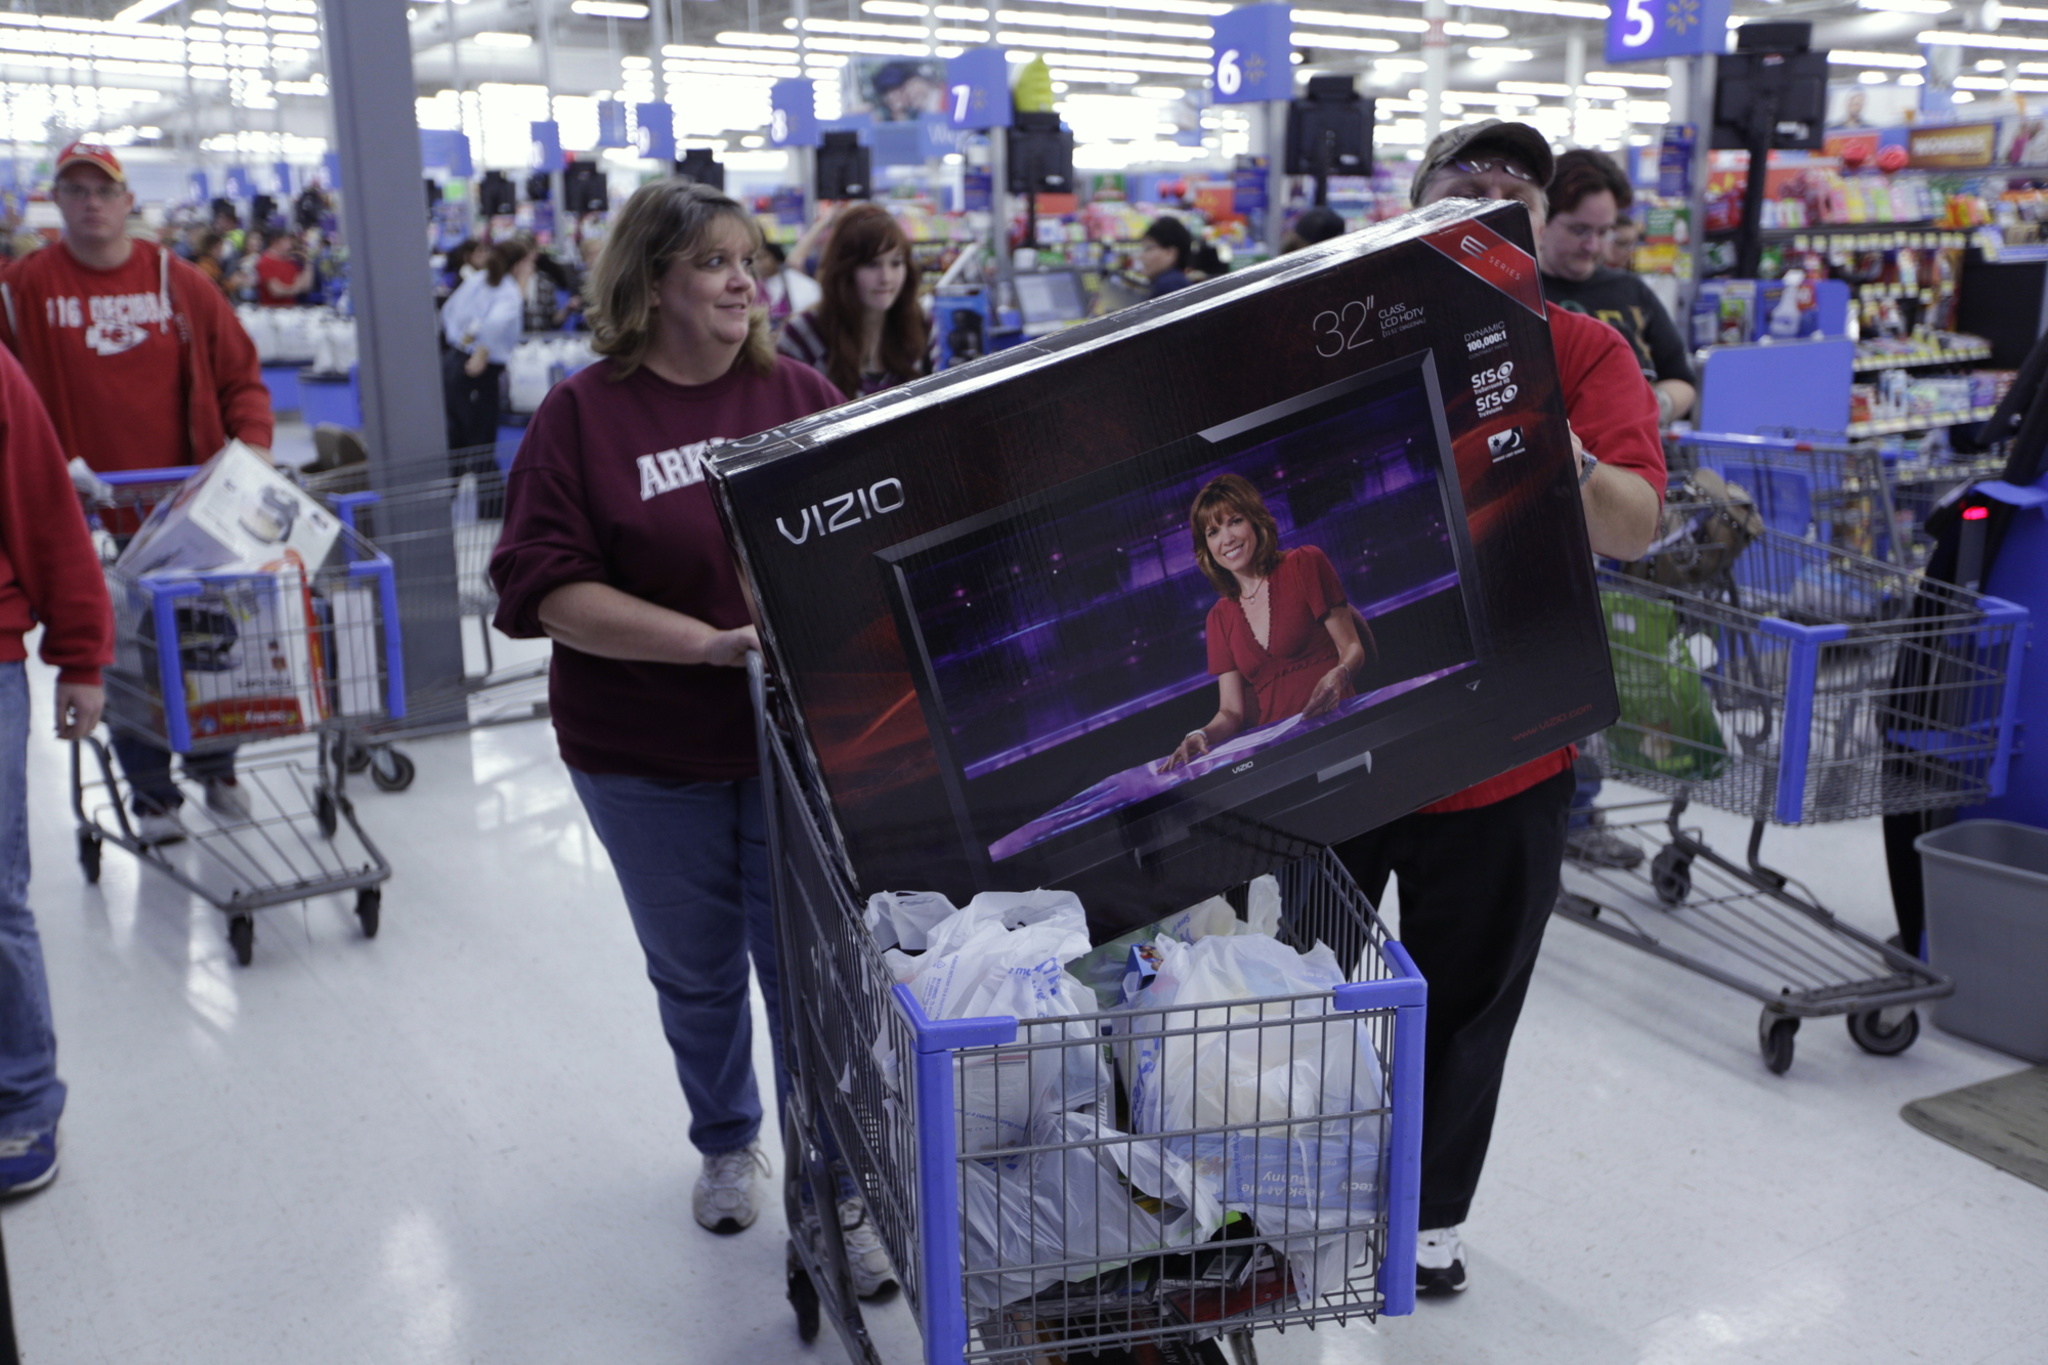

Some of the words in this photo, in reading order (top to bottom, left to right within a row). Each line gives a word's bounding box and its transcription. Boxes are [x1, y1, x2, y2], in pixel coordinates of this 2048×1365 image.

[1622, 0, 1655, 47] 5
[1217, 48, 1242, 95] 6
[951, 84, 971, 123] 7
[770, 108, 788, 143] 8
[1488, 255, 1521, 281] SERIES
[1377, 302, 1406, 319] CLASS
[1379, 315, 1399, 330] LCD
[1400, 306, 1424, 323] HDTV
[1312, 294, 1374, 358] 32"
[1463, 320, 1506, 342] DYNAMIC
[1466, 330, 1507, 352] 100,000:1
[775, 476, 905, 545] VIZIO
[1231, 760, 1254, 774] VIZIO
[1266, 1185, 1284, 1197] At
